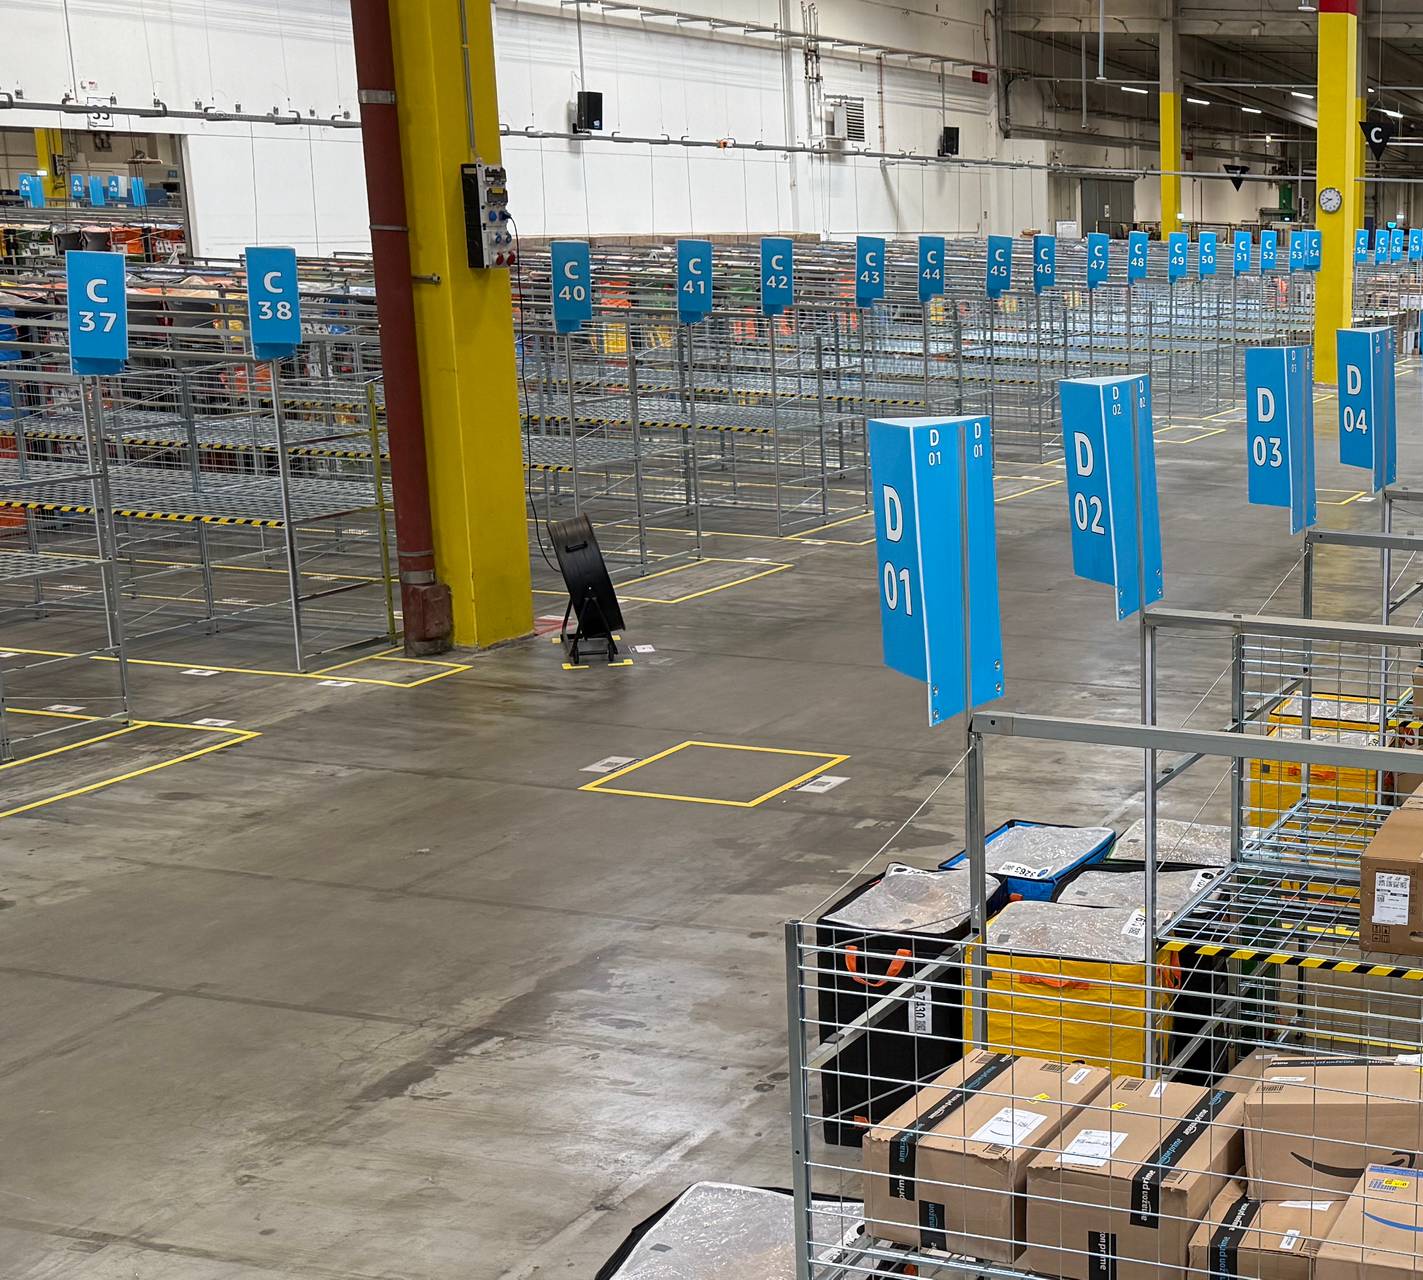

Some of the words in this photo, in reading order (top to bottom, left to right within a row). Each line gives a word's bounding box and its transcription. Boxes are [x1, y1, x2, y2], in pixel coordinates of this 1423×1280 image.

[1370, 127, 1383, 144] C
[1239, 240, 1246, 251] C
[1265, 240, 1272, 250] C
[1294, 240, 1301, 250] C
[1311, 238, 1318, 248] C
[1360, 236, 1365, 246] C
[1379, 236, 1385, 246] C
[1395, 236, 1400, 245] C
[1412, 236, 1418, 244] C
[1040, 248, 1049, 260] C
[1094, 246, 1103, 257] C
[1134, 244, 1143, 254] C
[1174, 242, 1182, 253] C
[1204, 242, 1212, 253] C
[865, 252, 876, 266] C
[926, 250, 937, 264] C
[995, 248, 1005, 262] C
[1130, 257, 1144, 267] 48
[1171, 256, 1184, 266] 49
[1201, 255, 1214, 264] 50
[1236, 252, 1247, 261] 51
[1263, 251, 1274, 259] 52
[1292, 251, 1302, 259] 53
[688, 258, 701, 274] C
[770, 255, 784, 270] C
[1036, 264, 1052, 274] 46
[1090, 260, 1106, 270] 47
[564, 260, 579, 280] C
[860, 270, 880, 284] 43
[922, 268, 940, 280] 44
[990, 266, 1008, 277] 45
[262, 270, 283, 294] C
[682, 280, 706, 295] 41
[766, 275, 788, 289] 42
[86, 278, 108, 303] C
[558, 285, 585, 302] 40
[256, 299, 292, 321] 38
[78, 310, 118, 334] 37
[1139, 380, 1144, 393] D
[1346, 365, 1362, 395] D
[1112, 386, 1120, 400] D
[1112, 404, 1122, 416] 02
[1257, 388, 1276, 422] D
[1343, 406, 1368, 435] 04
[929, 428, 940, 447] D
[974, 422, 982, 440] D
[974, 444, 984, 458] 01
[1074, 431, 1094, 478] D
[1252, 436, 1283, 468] 03
[928, 452, 942, 466] 01
[882, 484, 904, 543] D
[1074, 492, 1106, 536] 02
[883, 561, 912, 617] 01
[1142, 1170, 1156, 1192] prime
